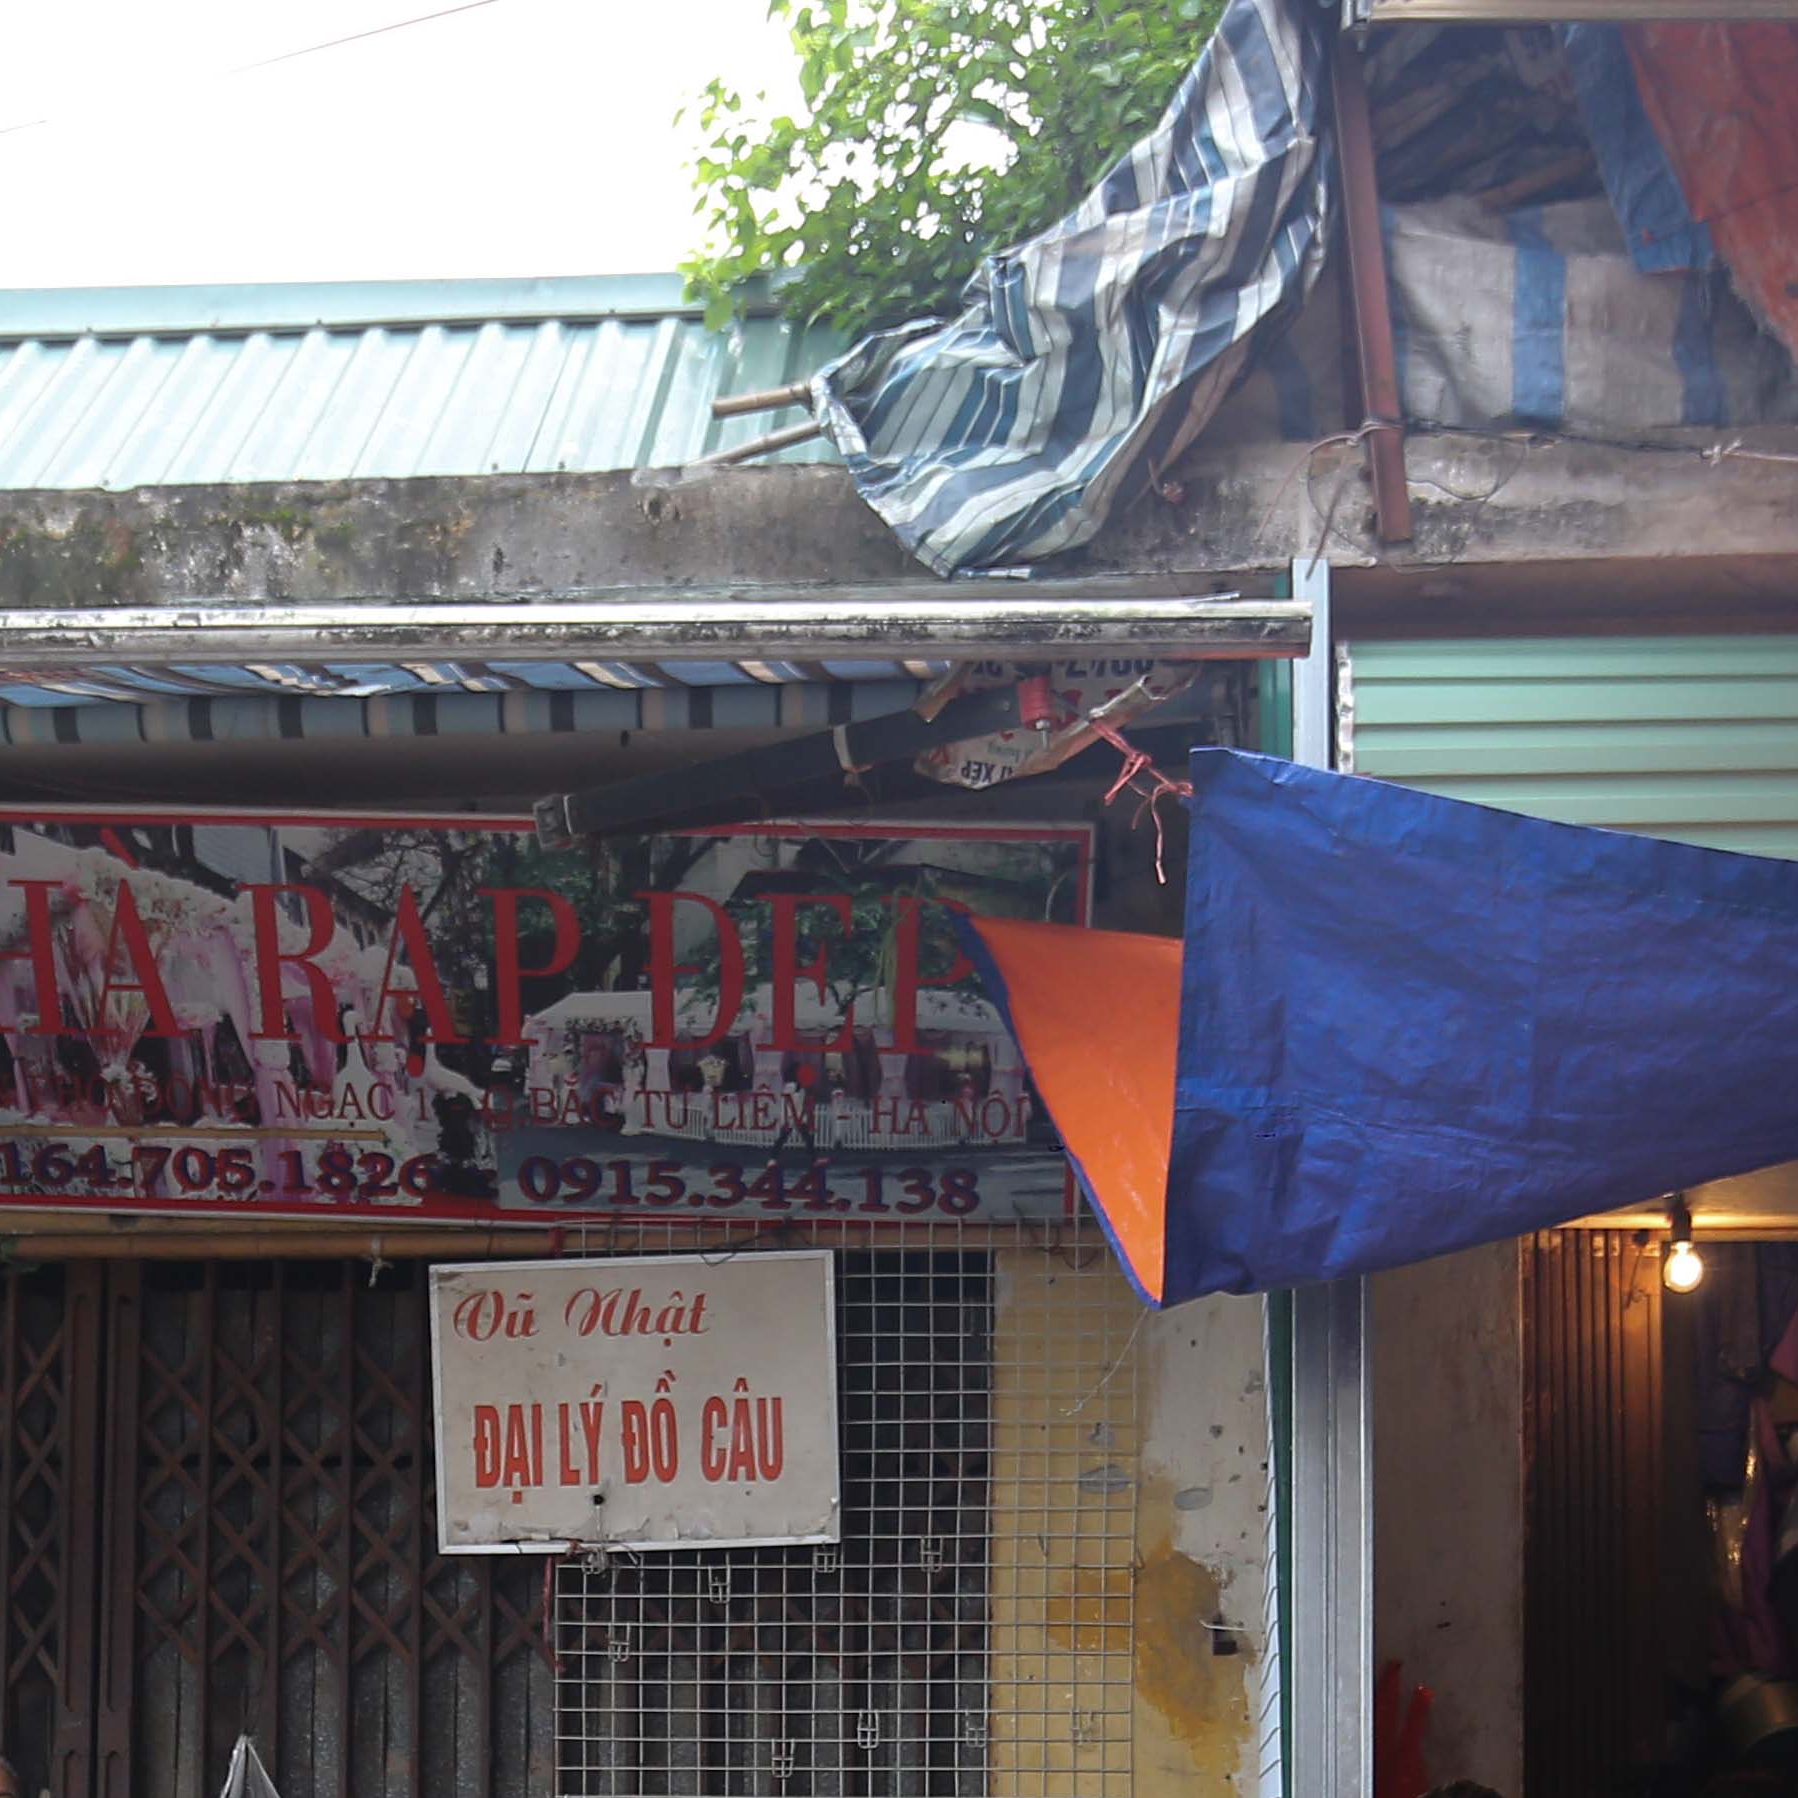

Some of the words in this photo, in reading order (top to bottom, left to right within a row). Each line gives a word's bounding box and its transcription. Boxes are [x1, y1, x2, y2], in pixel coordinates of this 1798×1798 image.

[239, 883, 581, 1077] RẠP
[635, 889, 975, 1088] ĐẸP
[516, 1154, 981, 1216] 0915.344.138
[453, 1289, 540, 1342] Vũ
[564, 1286, 711, 1348] Nhật
[473, 1403, 544, 1505] ĐẠI
[558, 1383, 604, 1487] LÝ
[620, 1369, 679, 1485] ĐỒ
[701, 1376, 784, 1484] CÂU
